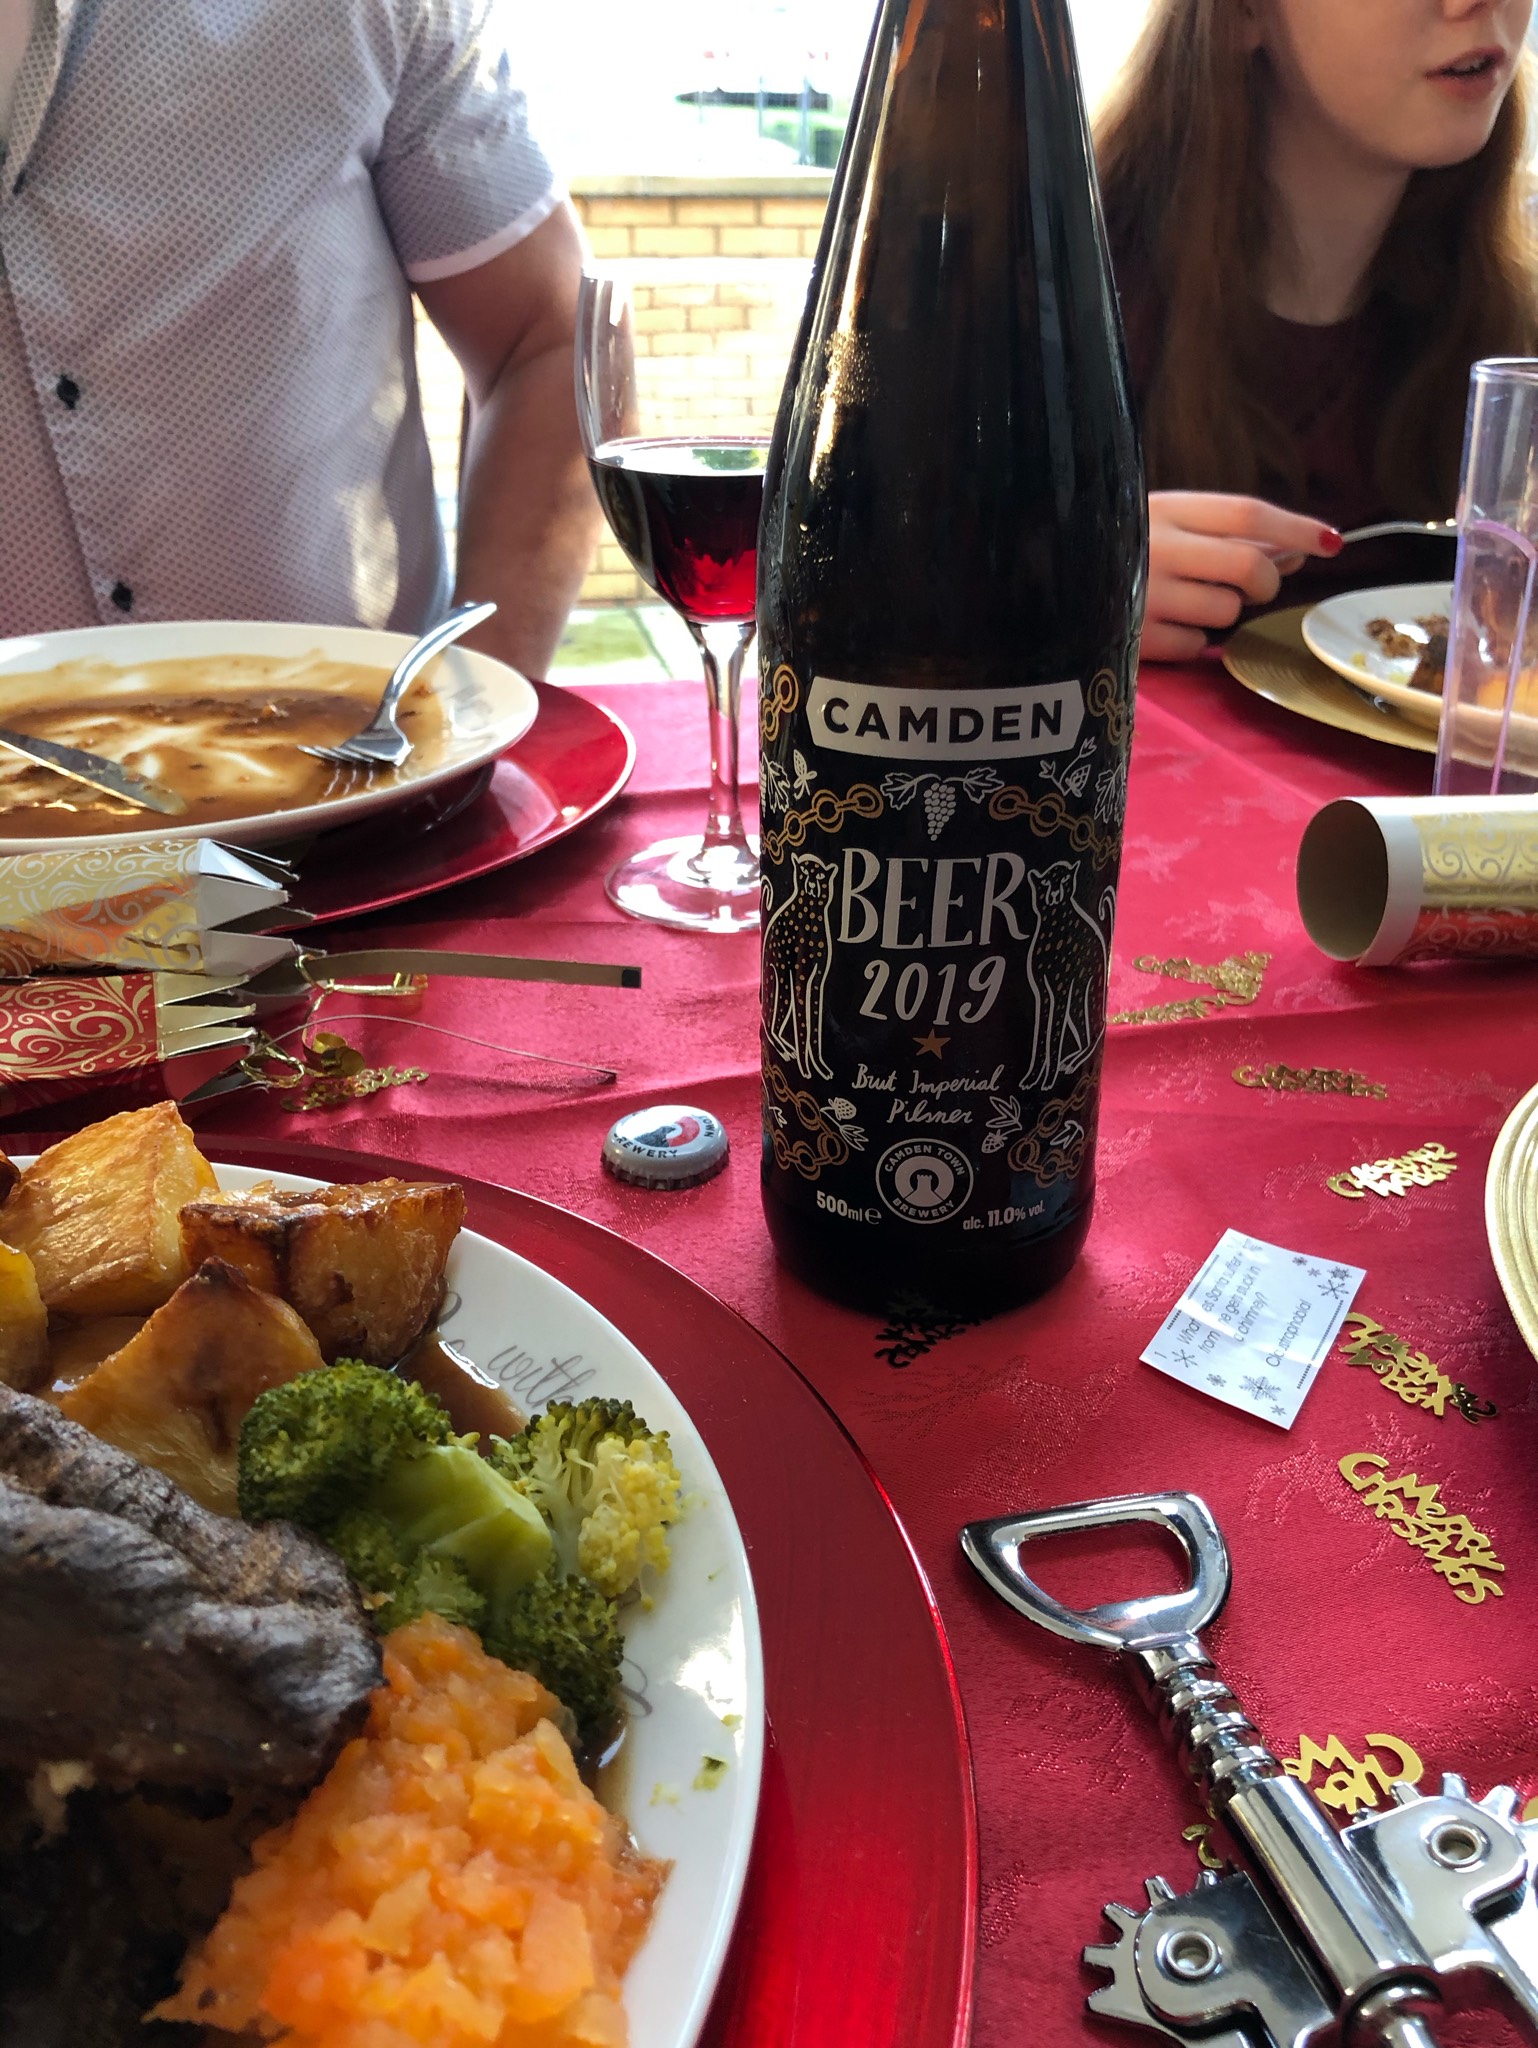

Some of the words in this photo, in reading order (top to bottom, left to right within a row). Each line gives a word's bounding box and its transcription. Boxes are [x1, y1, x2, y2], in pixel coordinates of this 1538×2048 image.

[823, 697, 1063, 744] CAMDEN
[837, 848, 1030, 950] BEER
[859, 956, 1006, 1026] 2019
[851, 1063, 898, 1092] Brut
[908, 1064, 1005, 1100] Imperial
[886, 1098, 973, 1124] Pilsner
[613, 1132, 678, 1158] REWERY
[884, 1145, 932, 1172] CAMDEN
[937, 1147, 966, 1176] TOWN
[892, 1197, 955, 1218] BREWERY
[962, 1215, 985, 1230] alc.
[987, 1206, 1026, 1228] 11.0%
[1028, 1199, 1045, 1217] vol.
